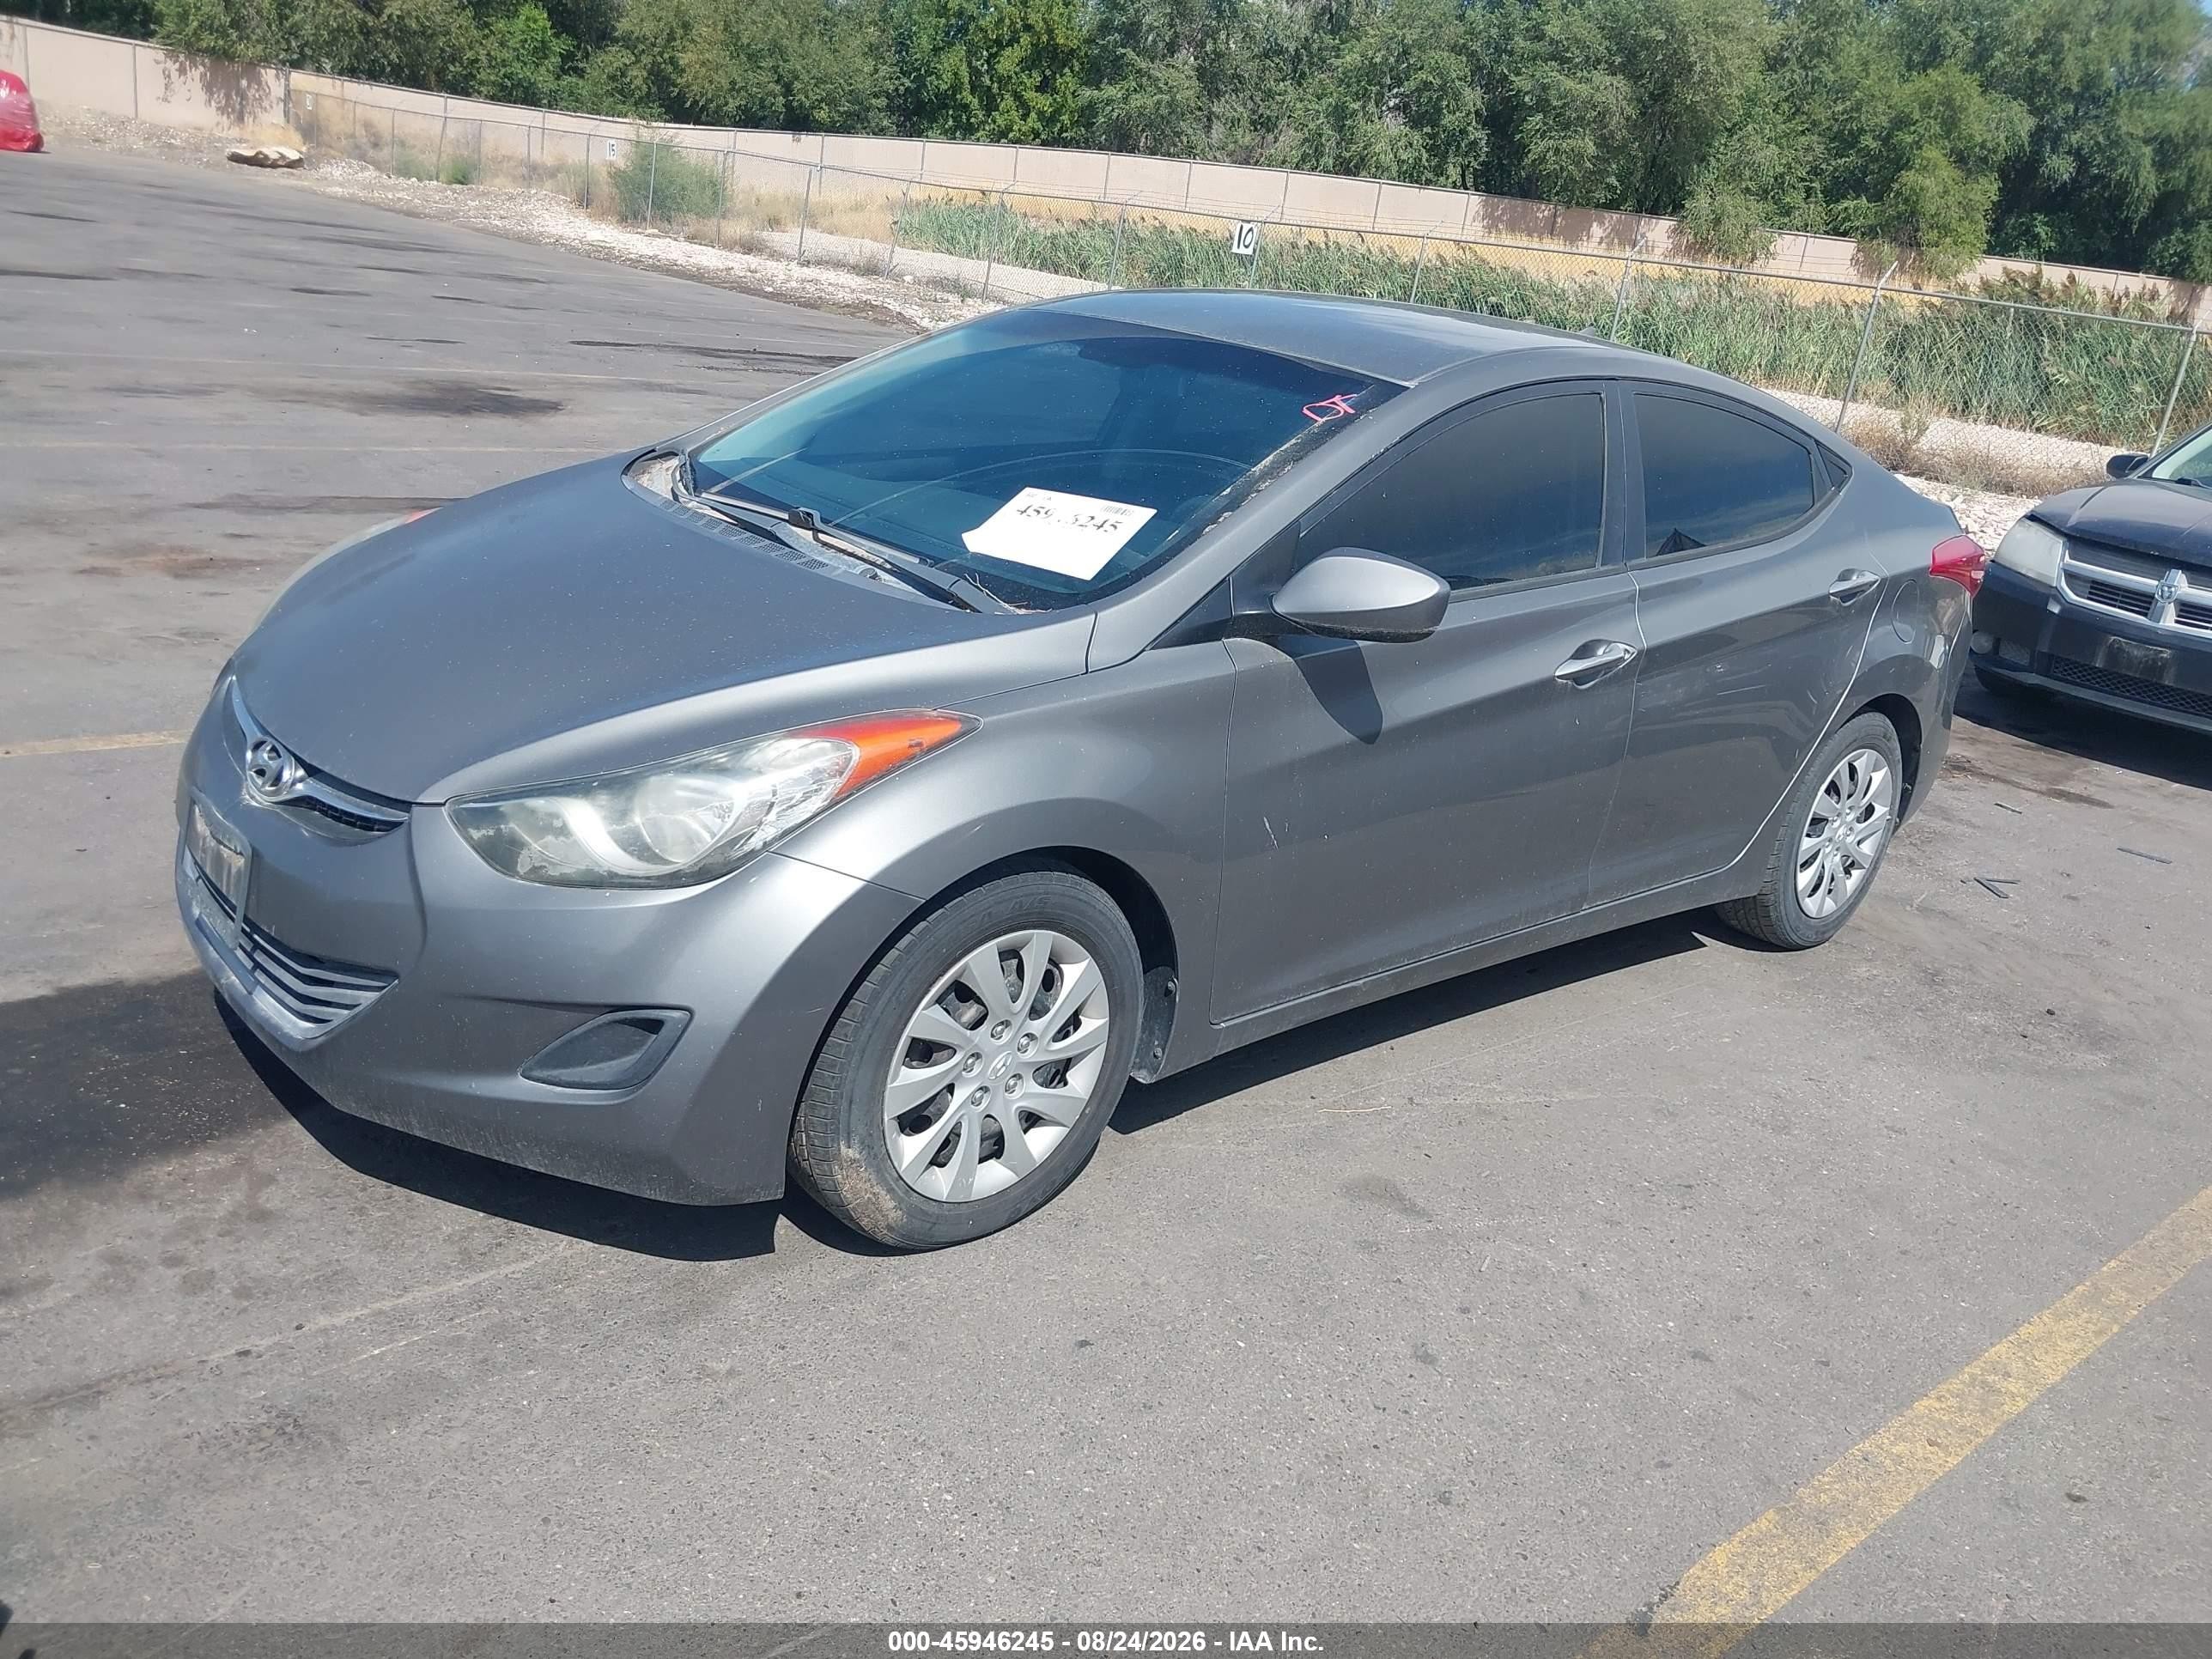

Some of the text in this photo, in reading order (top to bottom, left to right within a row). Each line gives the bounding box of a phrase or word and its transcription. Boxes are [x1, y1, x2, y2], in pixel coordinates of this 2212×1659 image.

[608, 142, 616, 157] 15
[1237, 223, 1255, 250] 10
[1016, 503, 1124, 533] 459245
